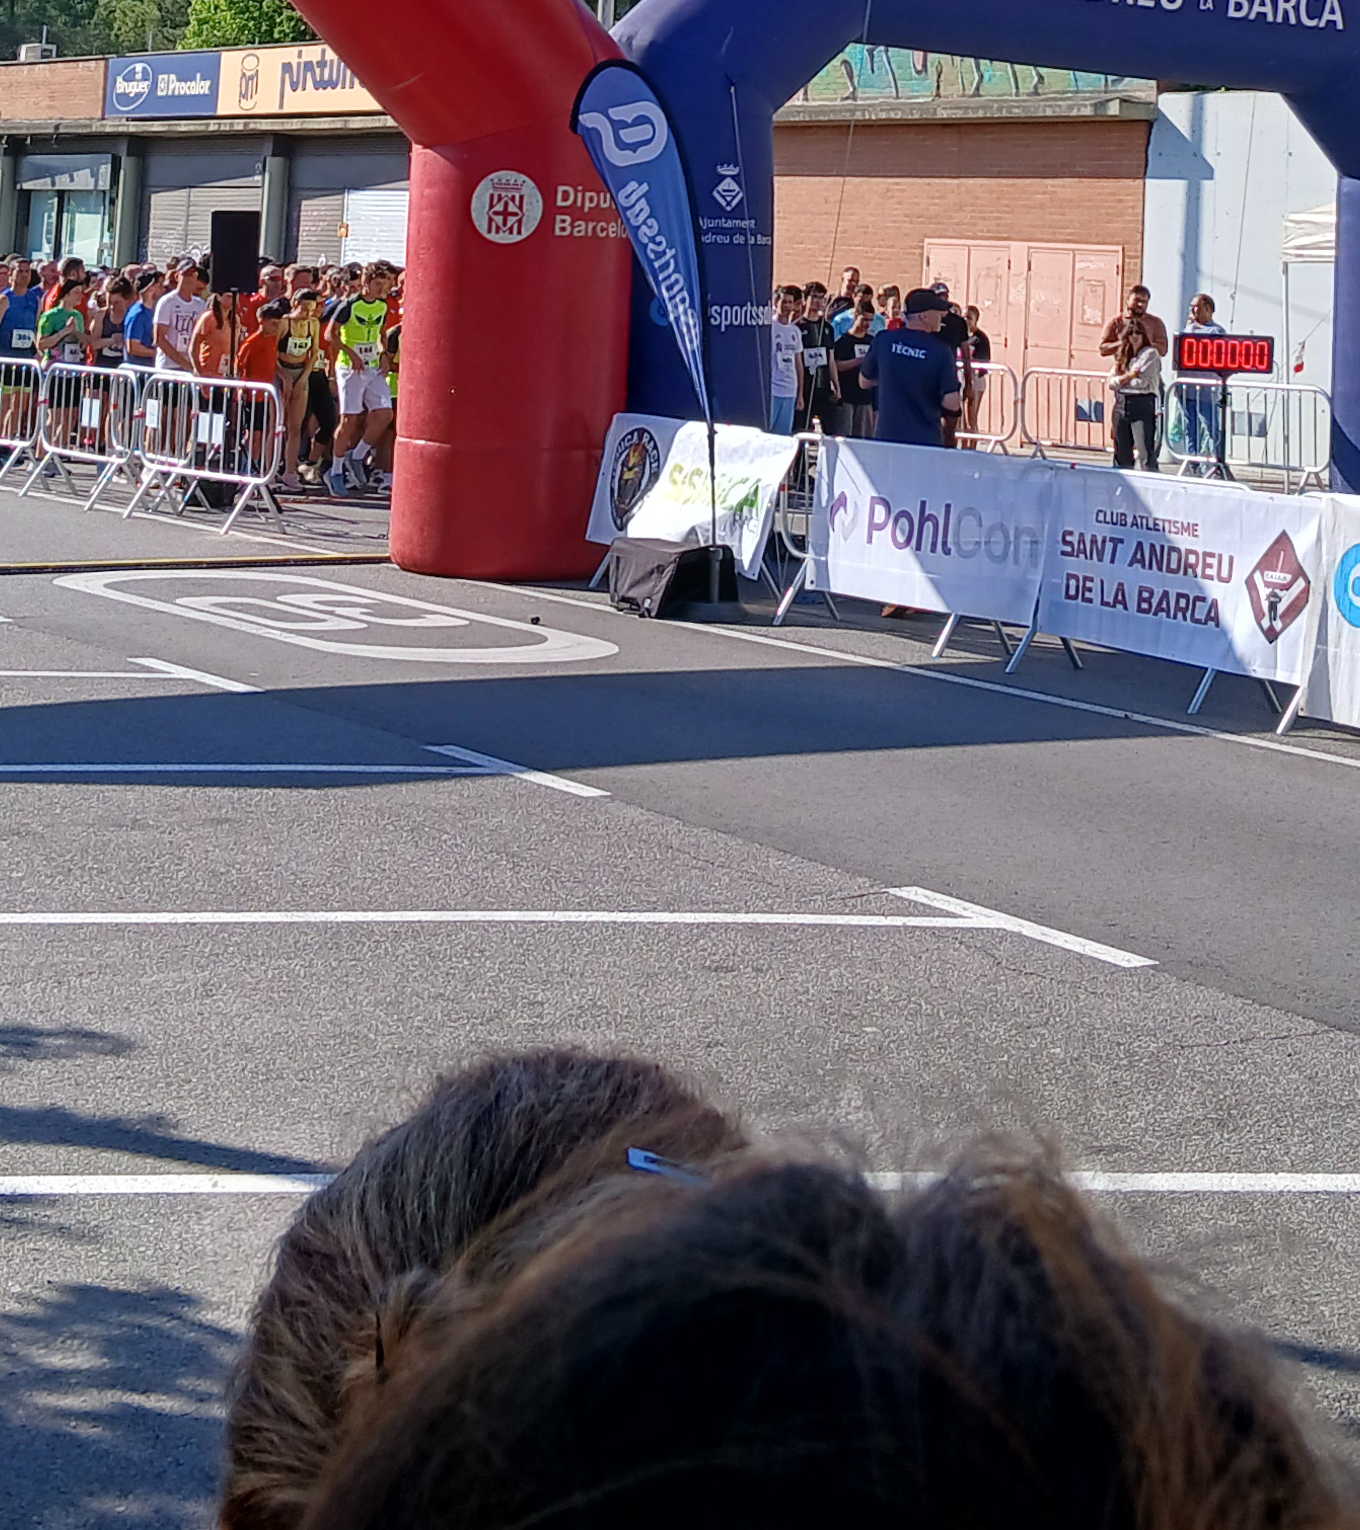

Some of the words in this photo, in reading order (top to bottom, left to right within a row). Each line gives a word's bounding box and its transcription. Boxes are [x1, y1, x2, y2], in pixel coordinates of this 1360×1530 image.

[556, 184, 616, 213] Dipu
[554, 214, 630, 239] Barcelo
[866, 495, 1038, 568] PohlCon
[1094, 509, 1128, 527] CLUB
[1130, 515, 1200, 538] ATLETISME
[1060, 530, 1124, 566] SANT
[1127, 539, 1235, 583] ANDREU
[1064, 572, 1094, 603] DE
[1100, 578, 1128, 611] LA
[1136, 584, 1220, 628] BARCA
